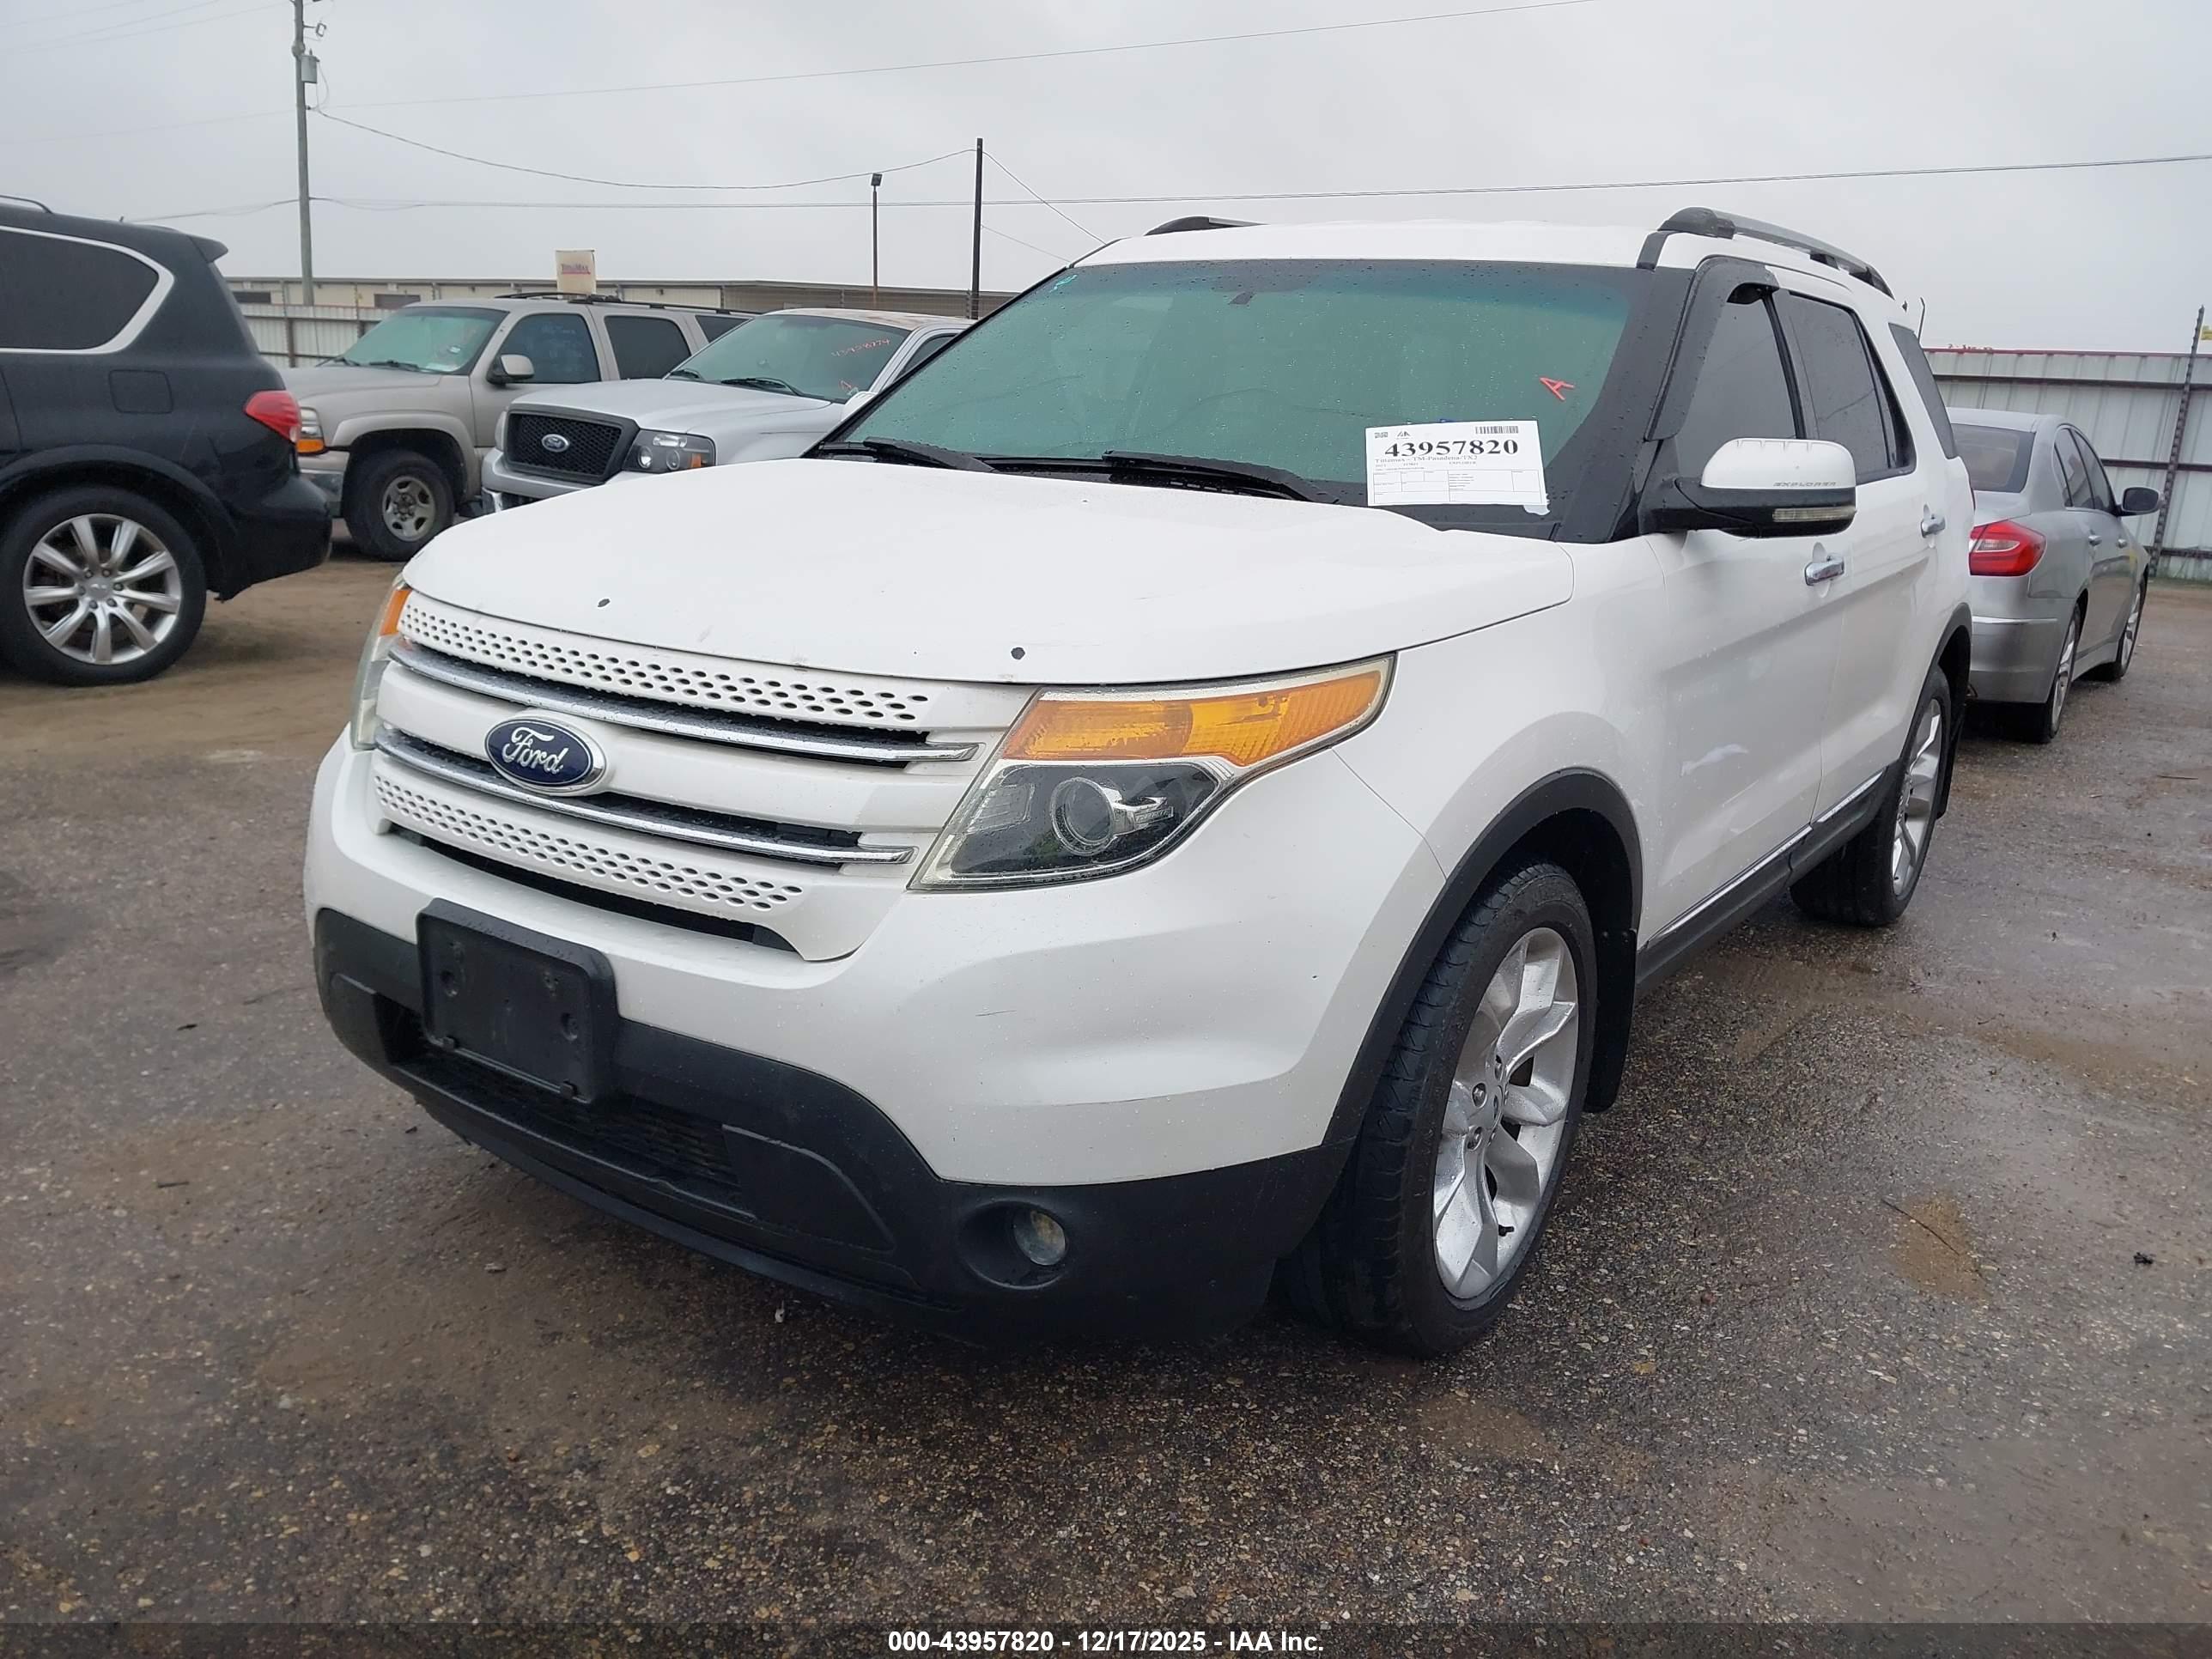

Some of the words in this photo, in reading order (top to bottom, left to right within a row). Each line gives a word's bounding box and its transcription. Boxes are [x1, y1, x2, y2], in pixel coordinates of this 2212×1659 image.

[1539, 377, 1575, 401] A
[1384, 439, 1519, 457] 43957820
[501, 726, 569, 775] Ford
